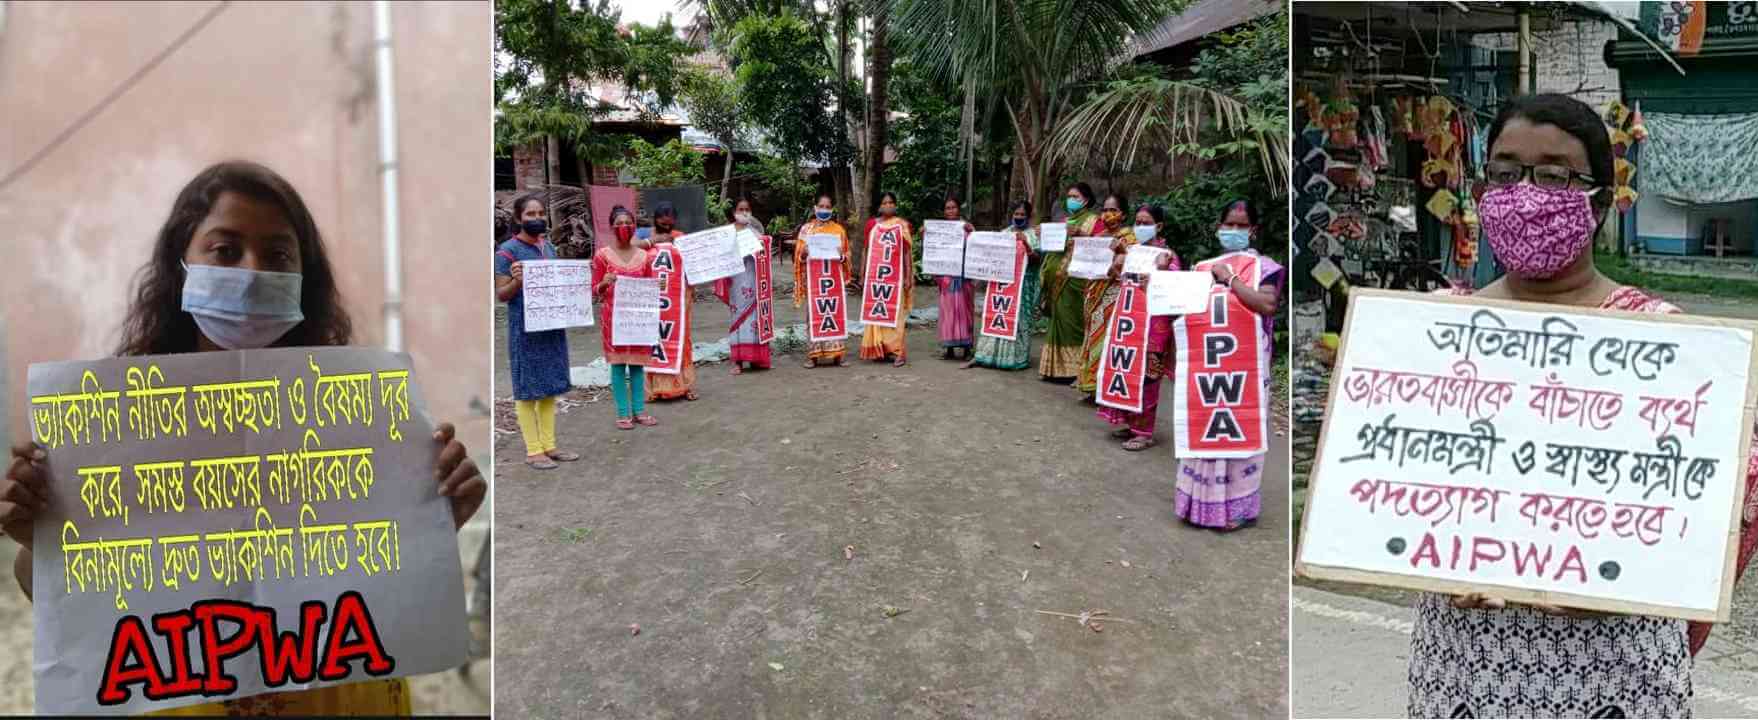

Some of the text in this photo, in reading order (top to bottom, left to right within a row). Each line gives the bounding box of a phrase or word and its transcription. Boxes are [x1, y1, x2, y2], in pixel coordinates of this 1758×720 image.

[815, 259, 839, 333] IPWA
[871, 230, 897, 319] AIPWA
[1194, 292, 1247, 442] IPWA
[1426, 310, 1679, 379] অতিমারি থেকে
[1344, 360, 1517, 421] ভারতবাসীকে
[1529, 372, 1623, 430] বাঁচাতে
[1512, 442, 1536, 475] ও
[1350, 477, 1510, 526] পদত্যাগ
[1410, 532, 1588, 583] AIPWA
